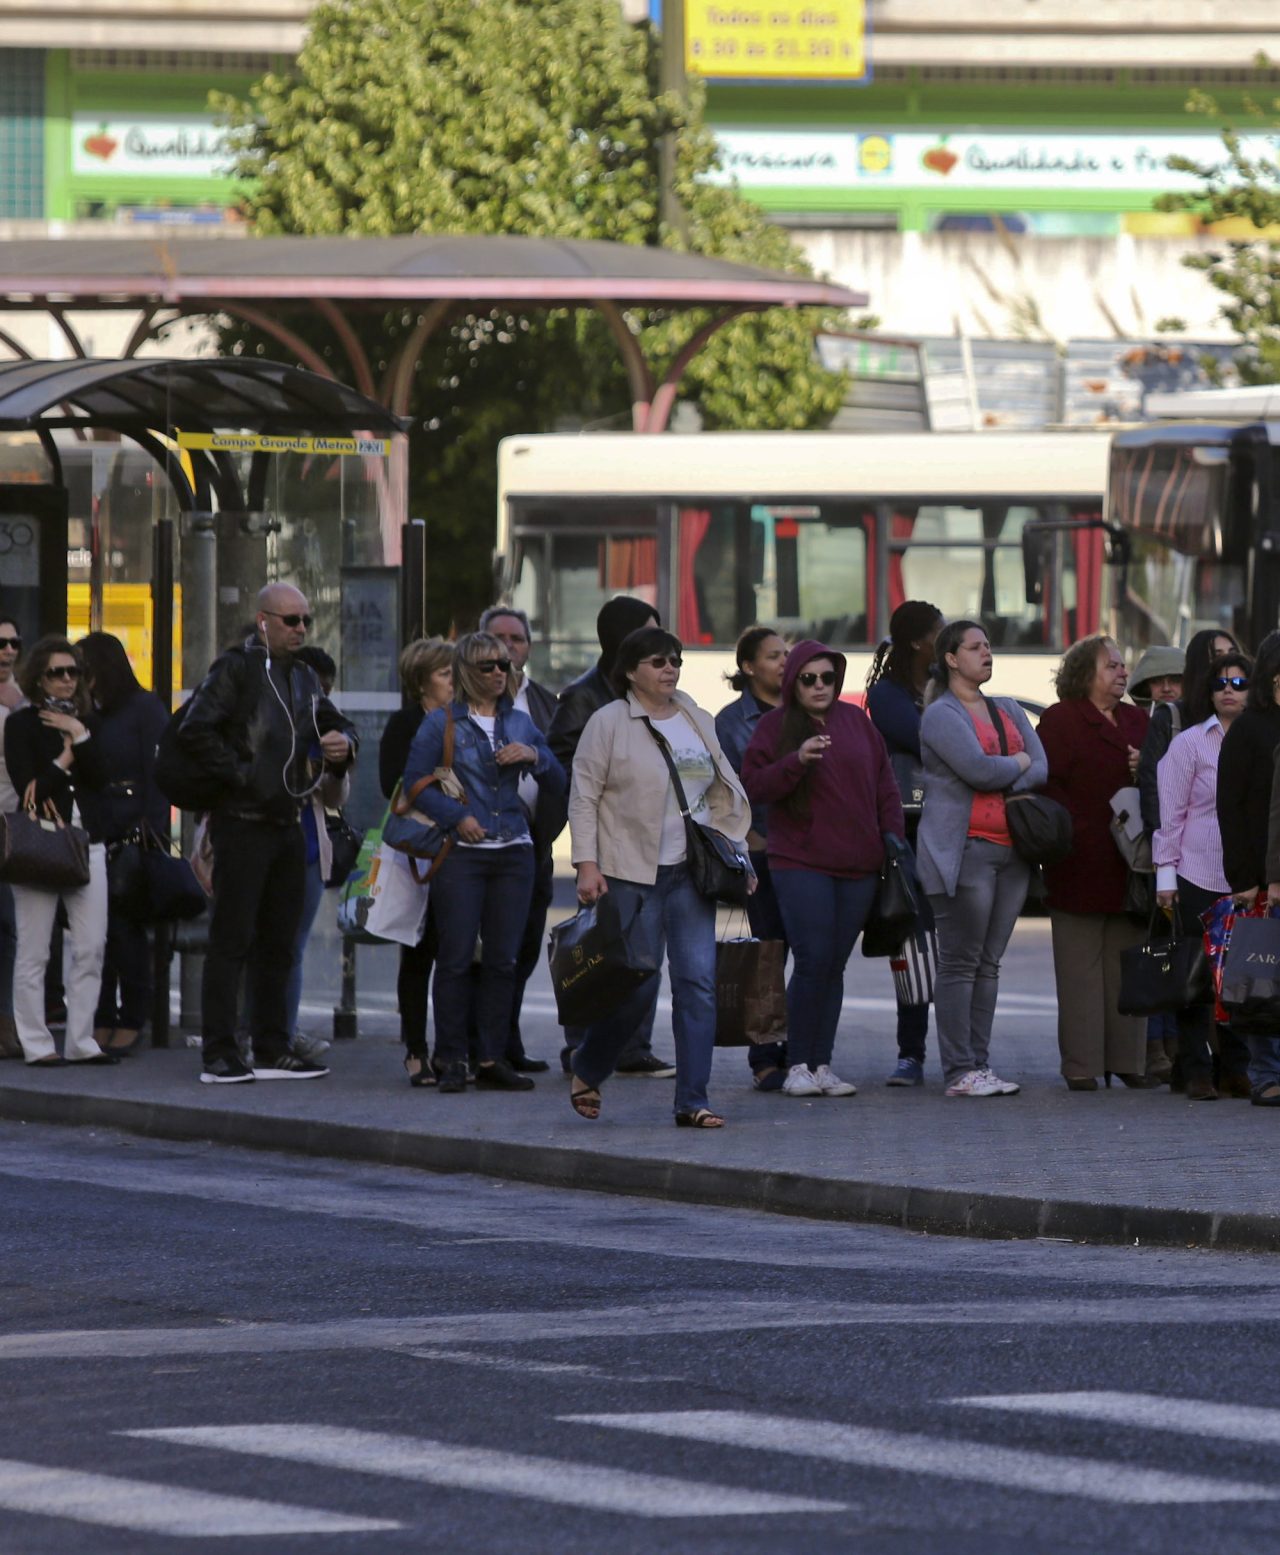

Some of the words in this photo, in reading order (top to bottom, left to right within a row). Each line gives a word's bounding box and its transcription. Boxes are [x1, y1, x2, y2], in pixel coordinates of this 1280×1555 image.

[708, 8, 761, 25] Todos
[211, 434, 256, 448] Campo
[260, 435, 308, 450] Grande
[312, 438, 357, 452] (Metro)
